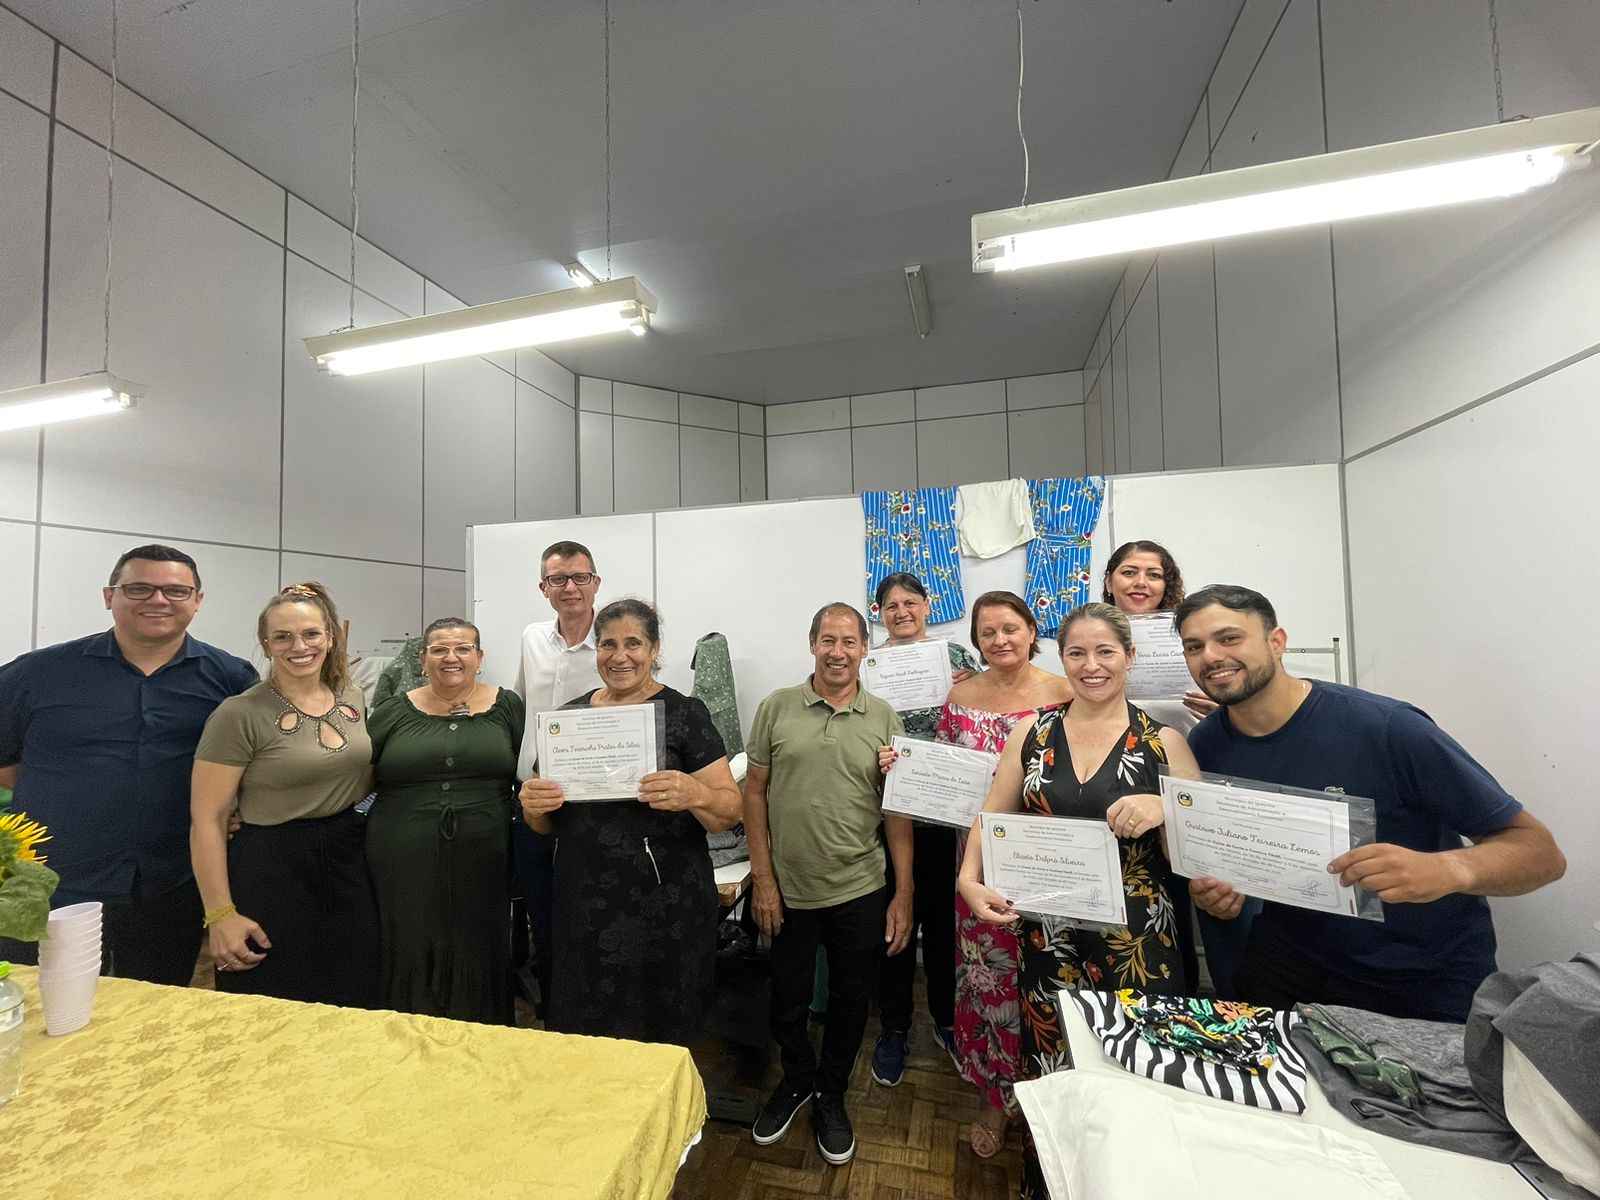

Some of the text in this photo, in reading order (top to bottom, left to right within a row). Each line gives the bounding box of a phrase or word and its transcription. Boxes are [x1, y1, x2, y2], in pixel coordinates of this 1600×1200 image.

[1184, 820, 1216, 834] Gustavo
[1250, 834, 1289, 851] Teixeira
[1289, 843, 1322, 857] Lemos
